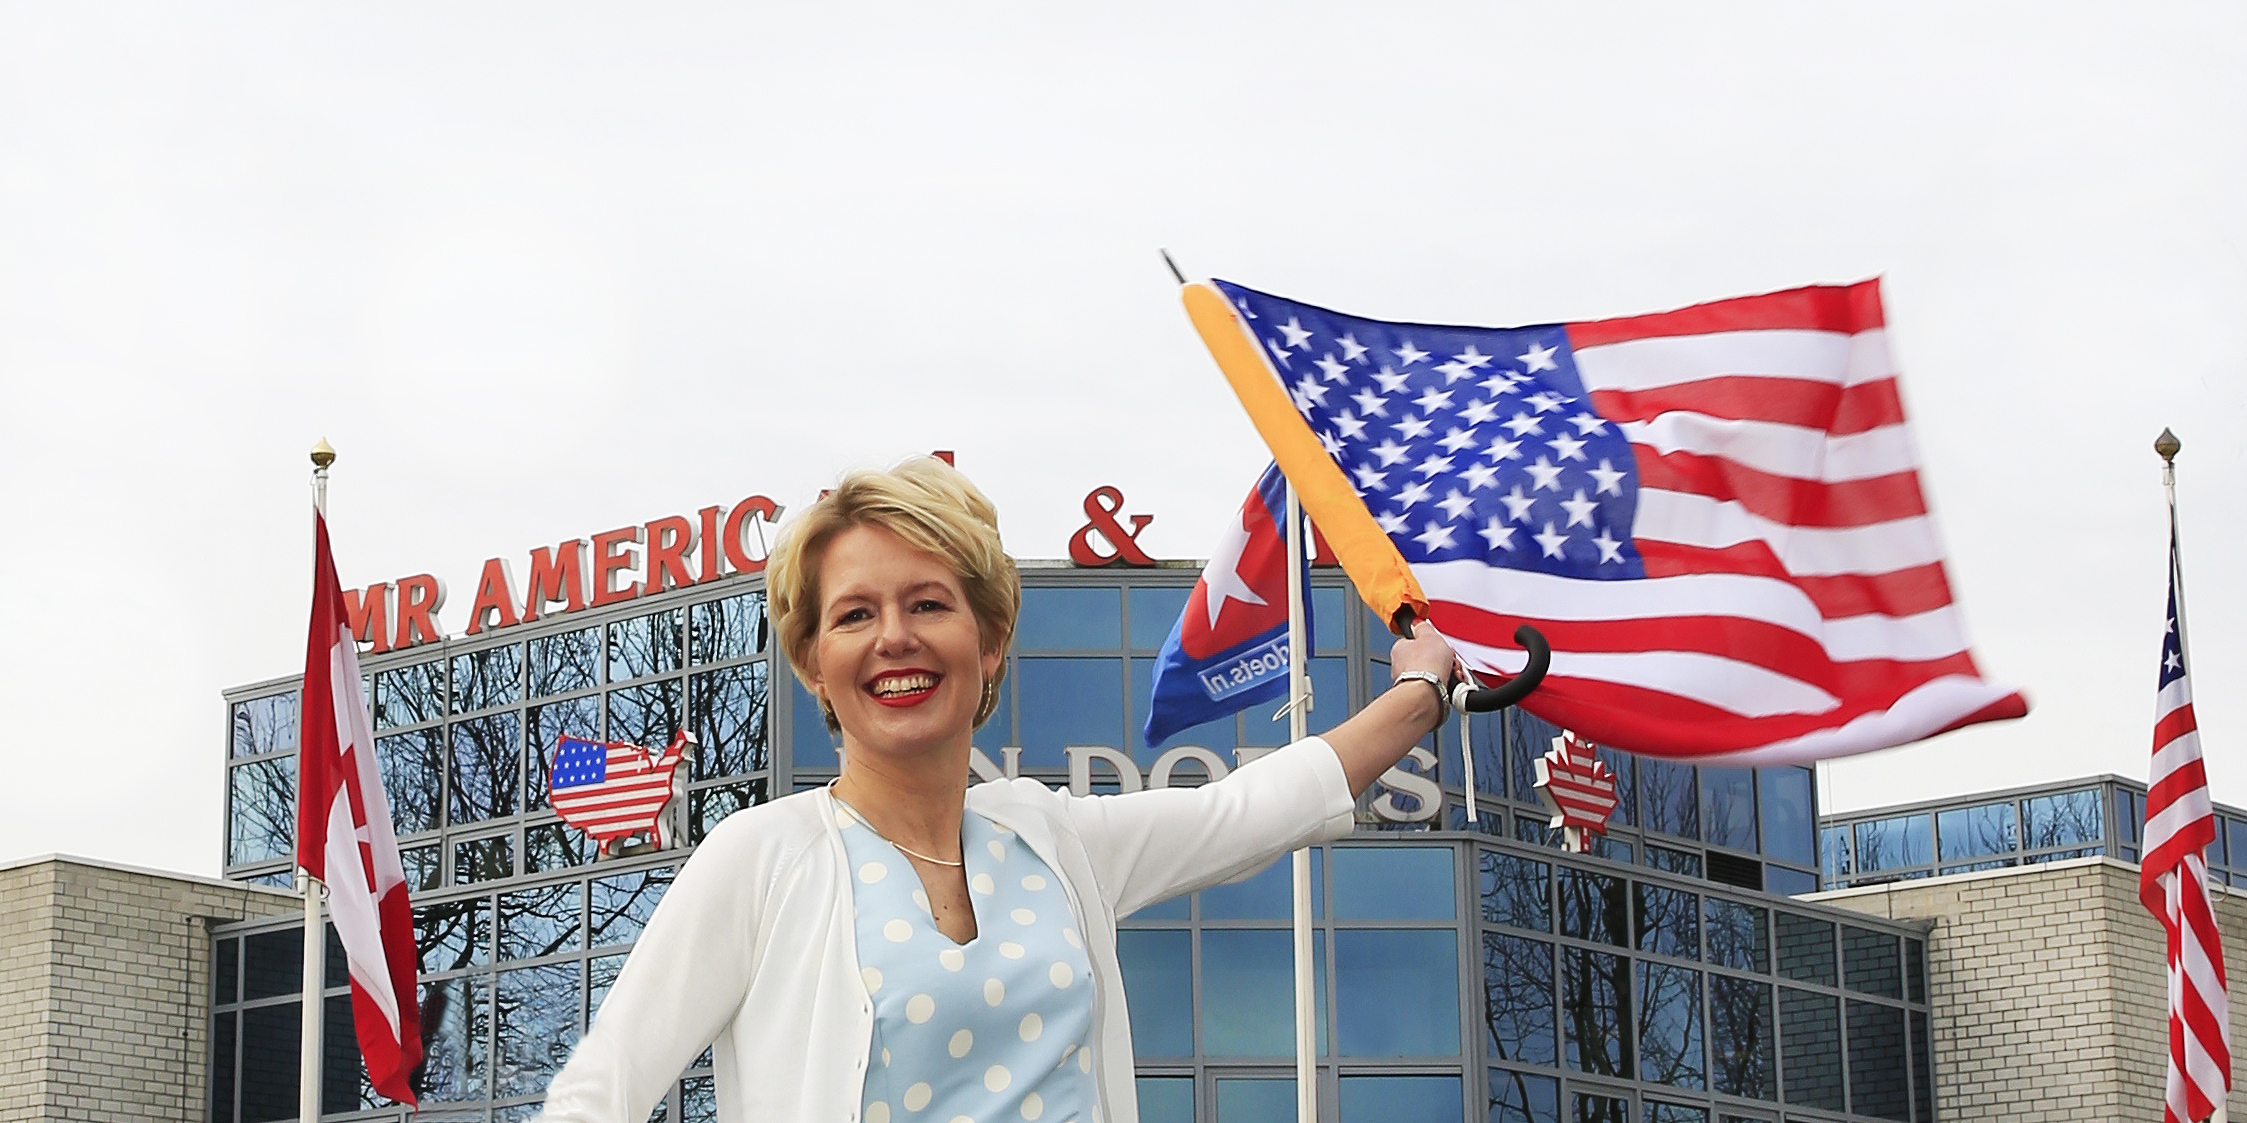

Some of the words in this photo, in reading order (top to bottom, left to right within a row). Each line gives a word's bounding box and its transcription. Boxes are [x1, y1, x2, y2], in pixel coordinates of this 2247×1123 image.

[342, 573, 442, 654] MR
[465, 490, 834, 635] AMERIC
[1068, 486, 1156, 566] &
[1064, 746, 1442, 823] DOS
